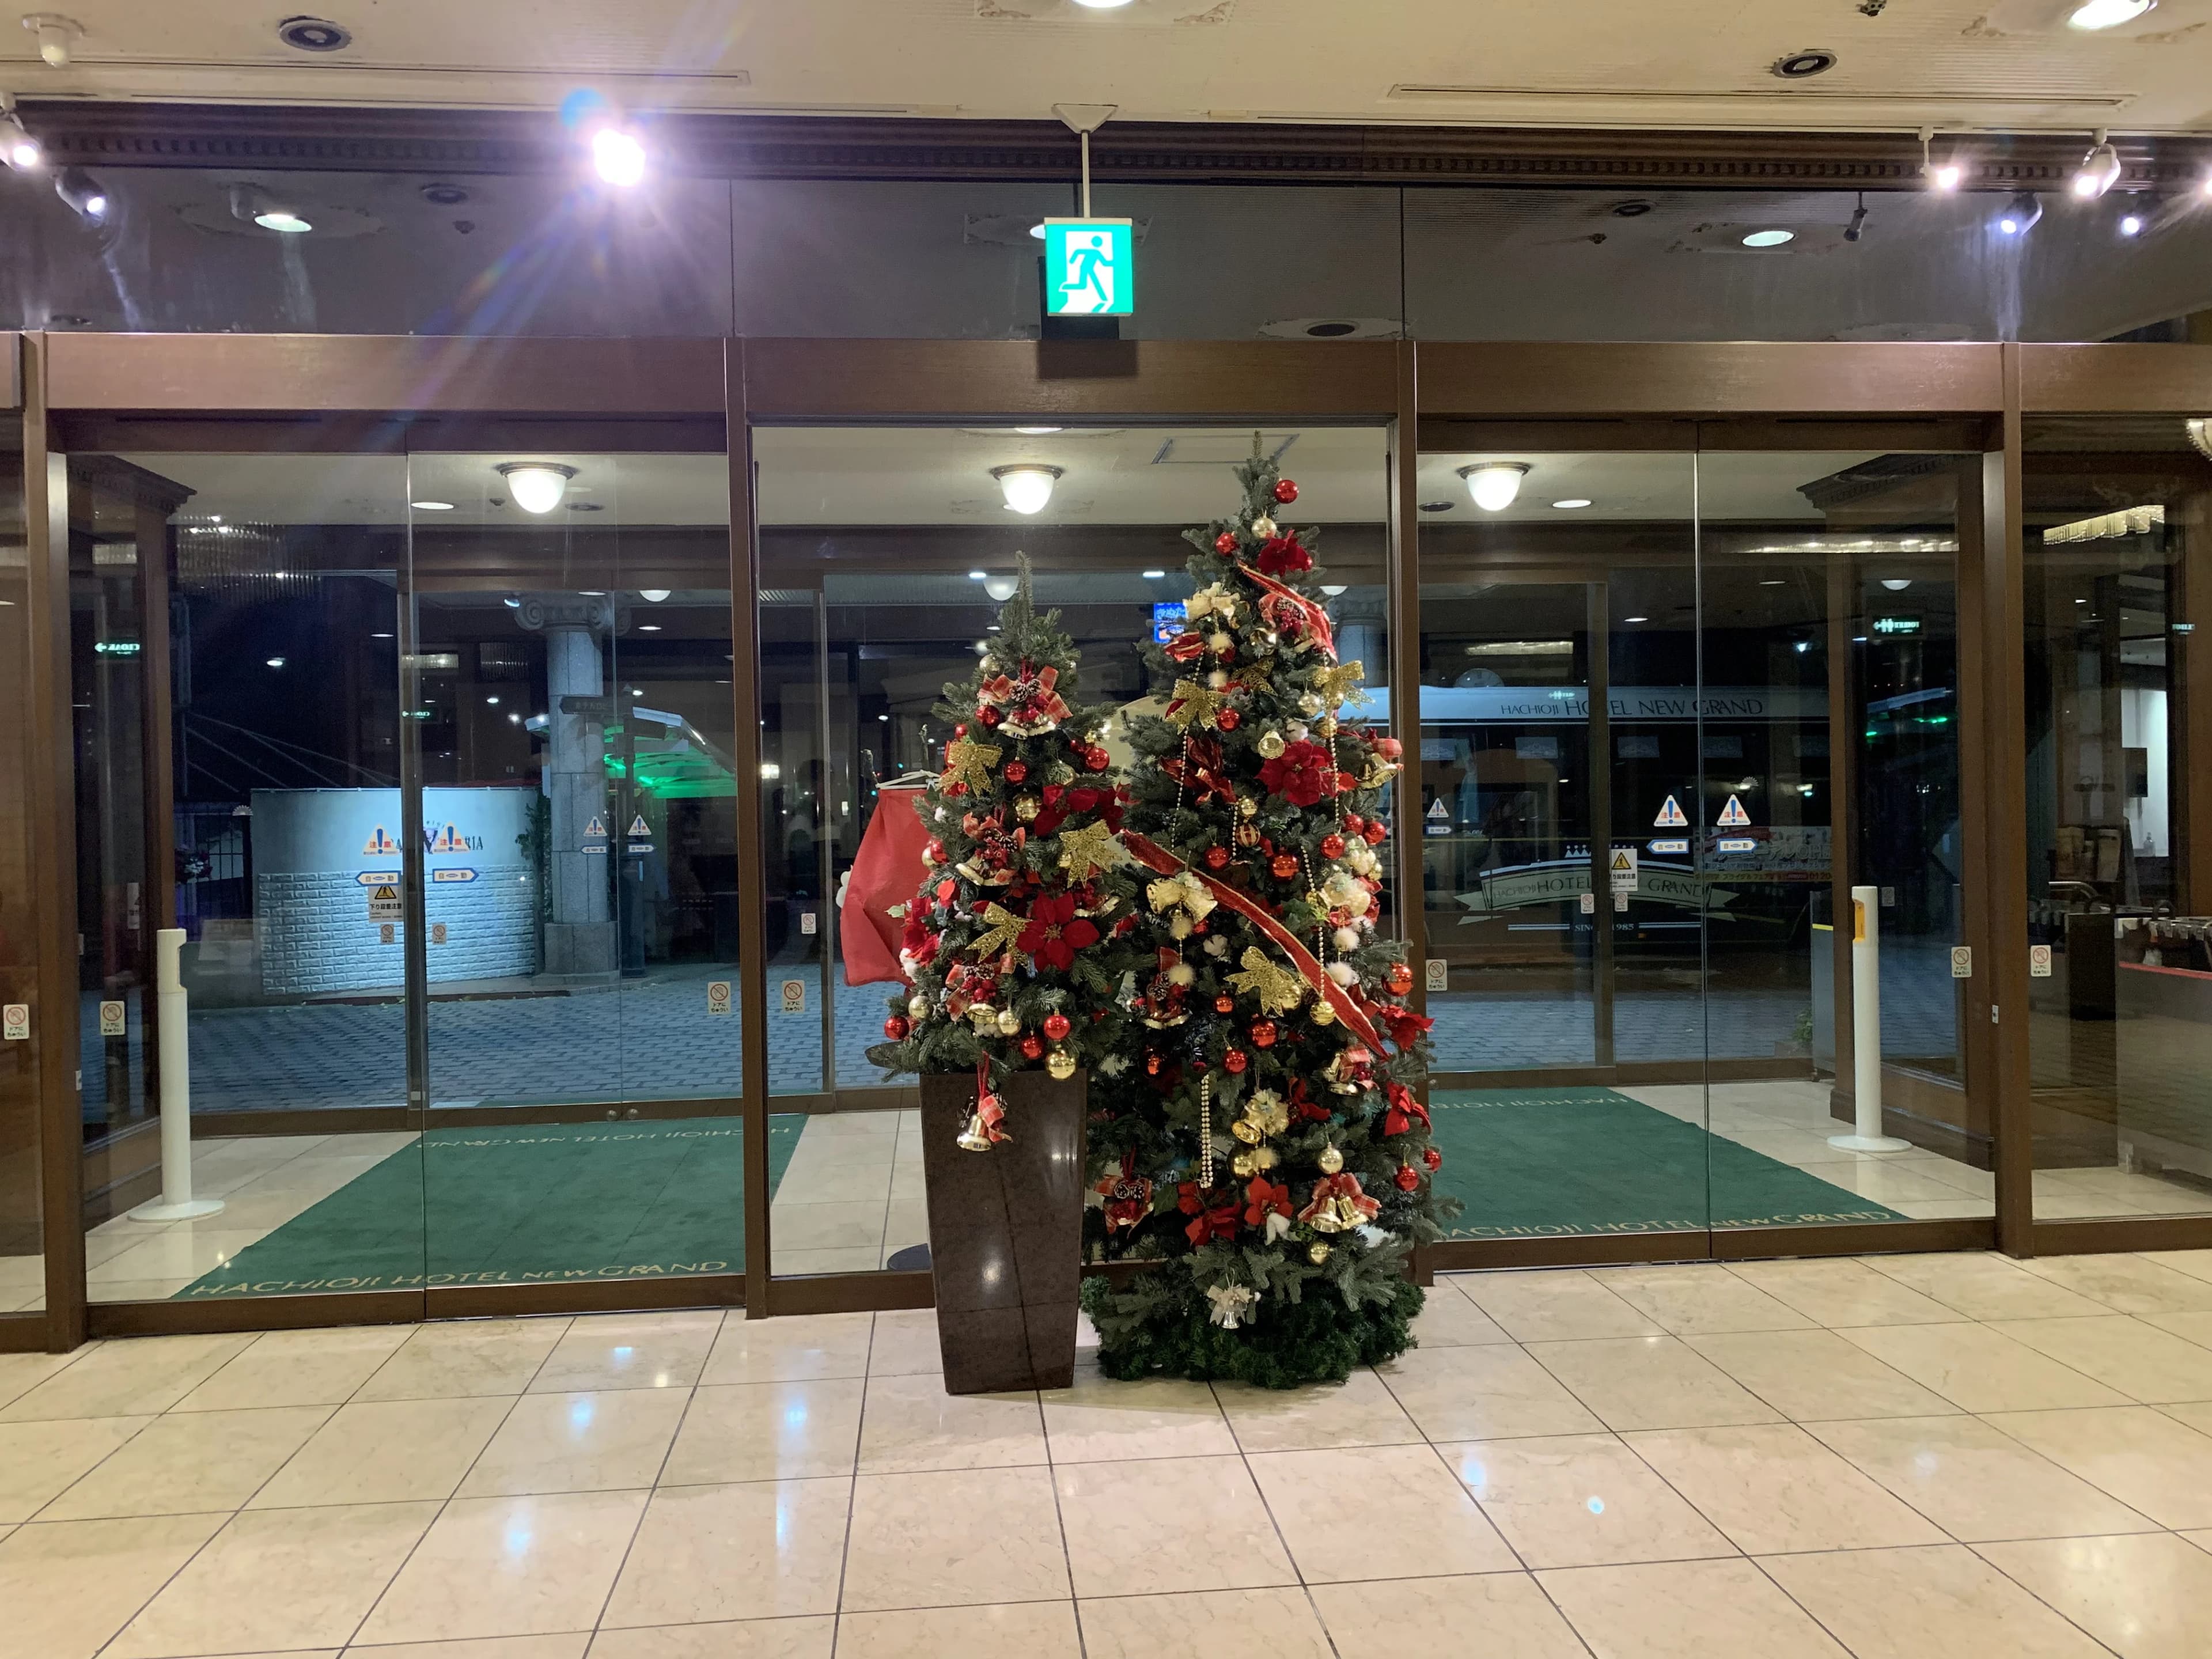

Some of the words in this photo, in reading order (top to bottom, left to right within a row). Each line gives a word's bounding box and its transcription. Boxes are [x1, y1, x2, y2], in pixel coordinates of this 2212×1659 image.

[1501, 704, 1559, 715] HACHIOJI
[1565, 700, 1633, 715] HEL
[1638, 700, 1685, 715] NEW
[1692, 699, 1763, 715] GRAND
[1537, 876, 1592, 893] HOTEL
[416, 1138, 510, 1148] GRAND
[574, 1133, 656, 1142] HOTEL
[1450, 1223, 1582, 1238] ACHIOJI
[1591, 1219, 1705, 1232] HOTEL
[1711, 1218, 1770, 1228] NEW
[1772, 1211, 1892, 1224] GRAND
[190, 1277, 382, 1296] HACHIOJI
[391, 1271, 512, 1285] HOTEL
[522, 1268, 593, 1279] NEW
[597, 1261, 728, 1275] GRAND
